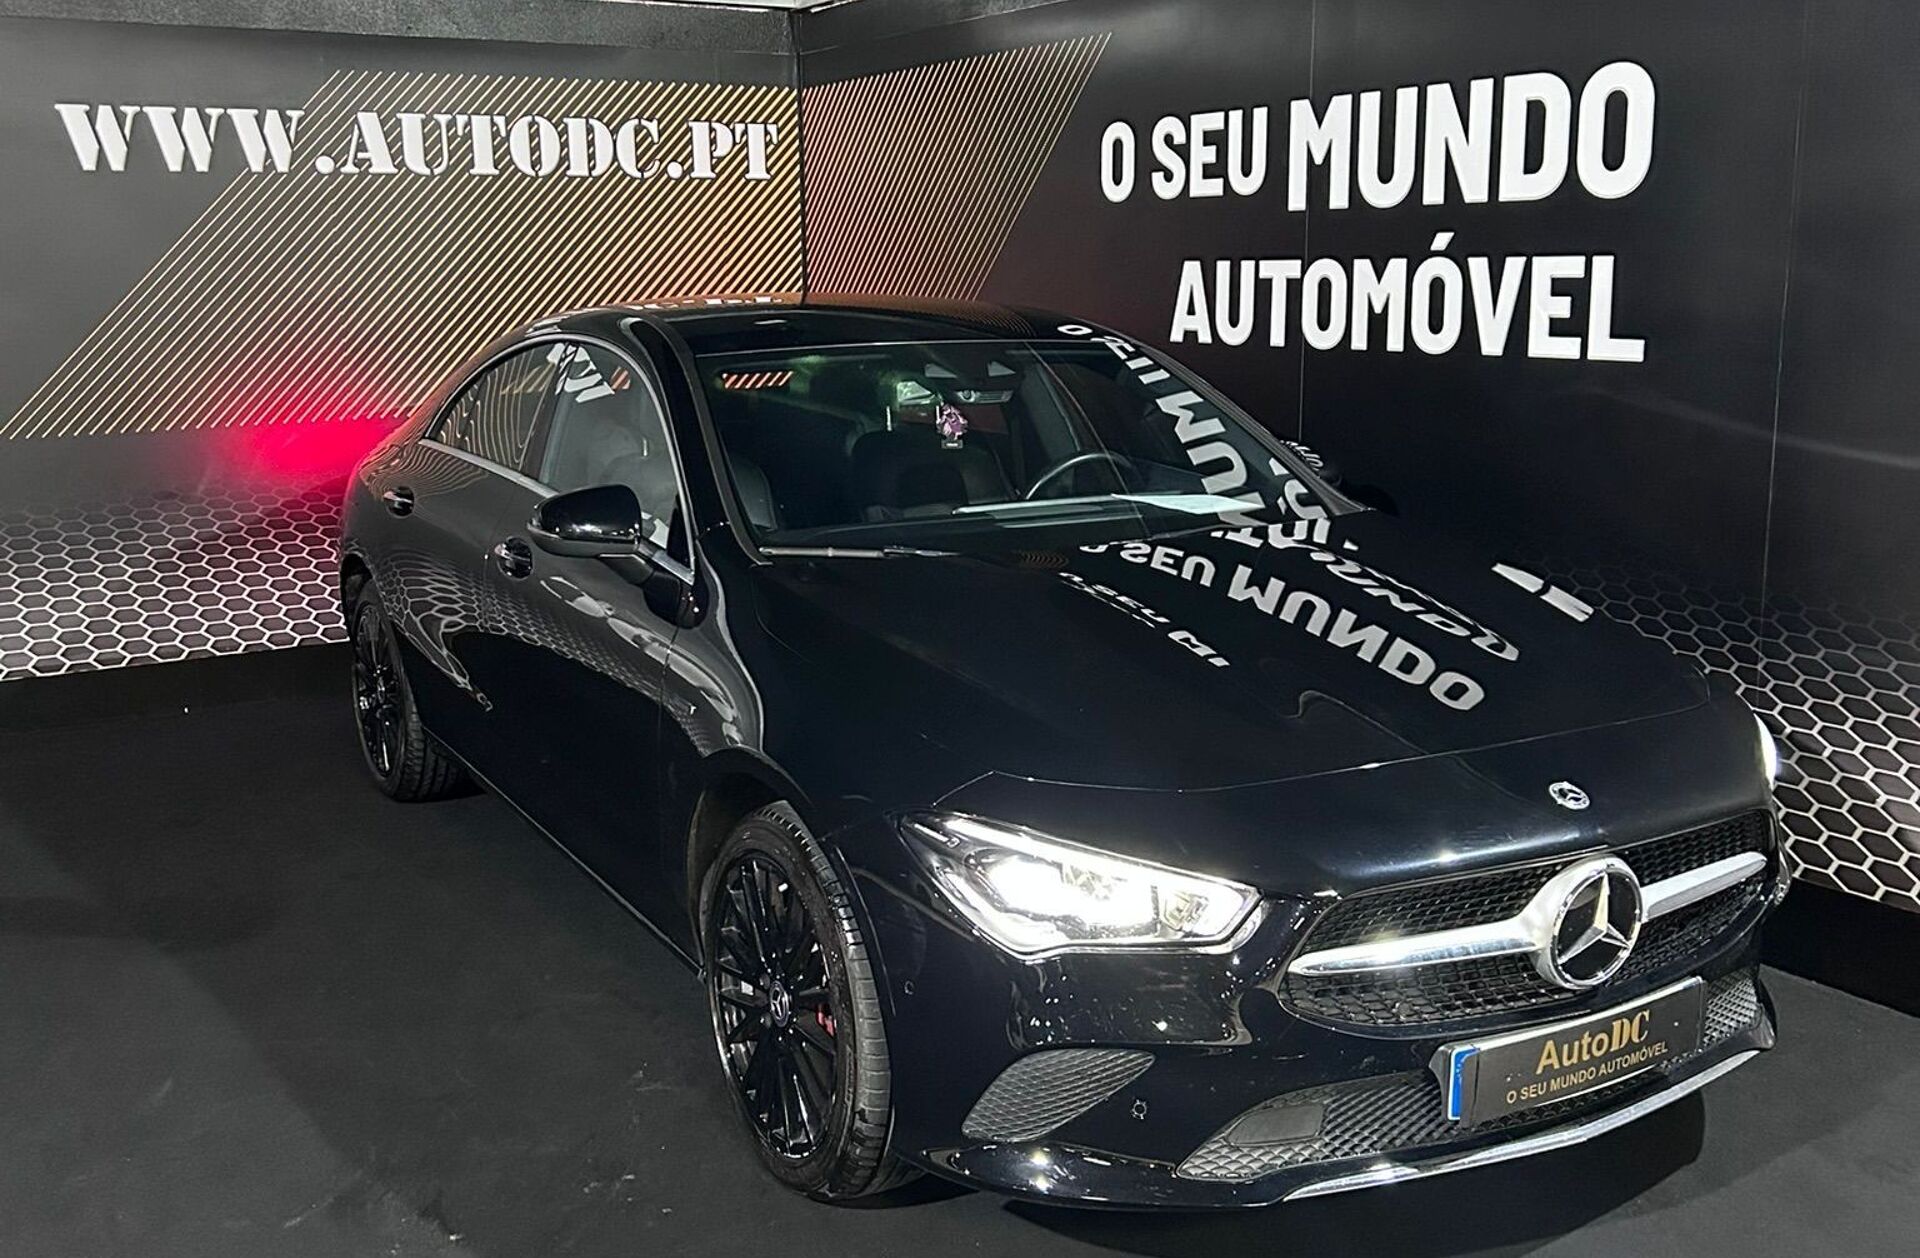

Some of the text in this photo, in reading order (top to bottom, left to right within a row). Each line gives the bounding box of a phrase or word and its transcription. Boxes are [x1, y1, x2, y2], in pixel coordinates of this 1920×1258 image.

[1100, 60, 1656, 212] O SEU MUNDO
[1169, 231, 1646, 364] AUTOMÓVEL
[1506, 1043, 1668, 1104] O SEU MUNDO AUTOMÓVEL
